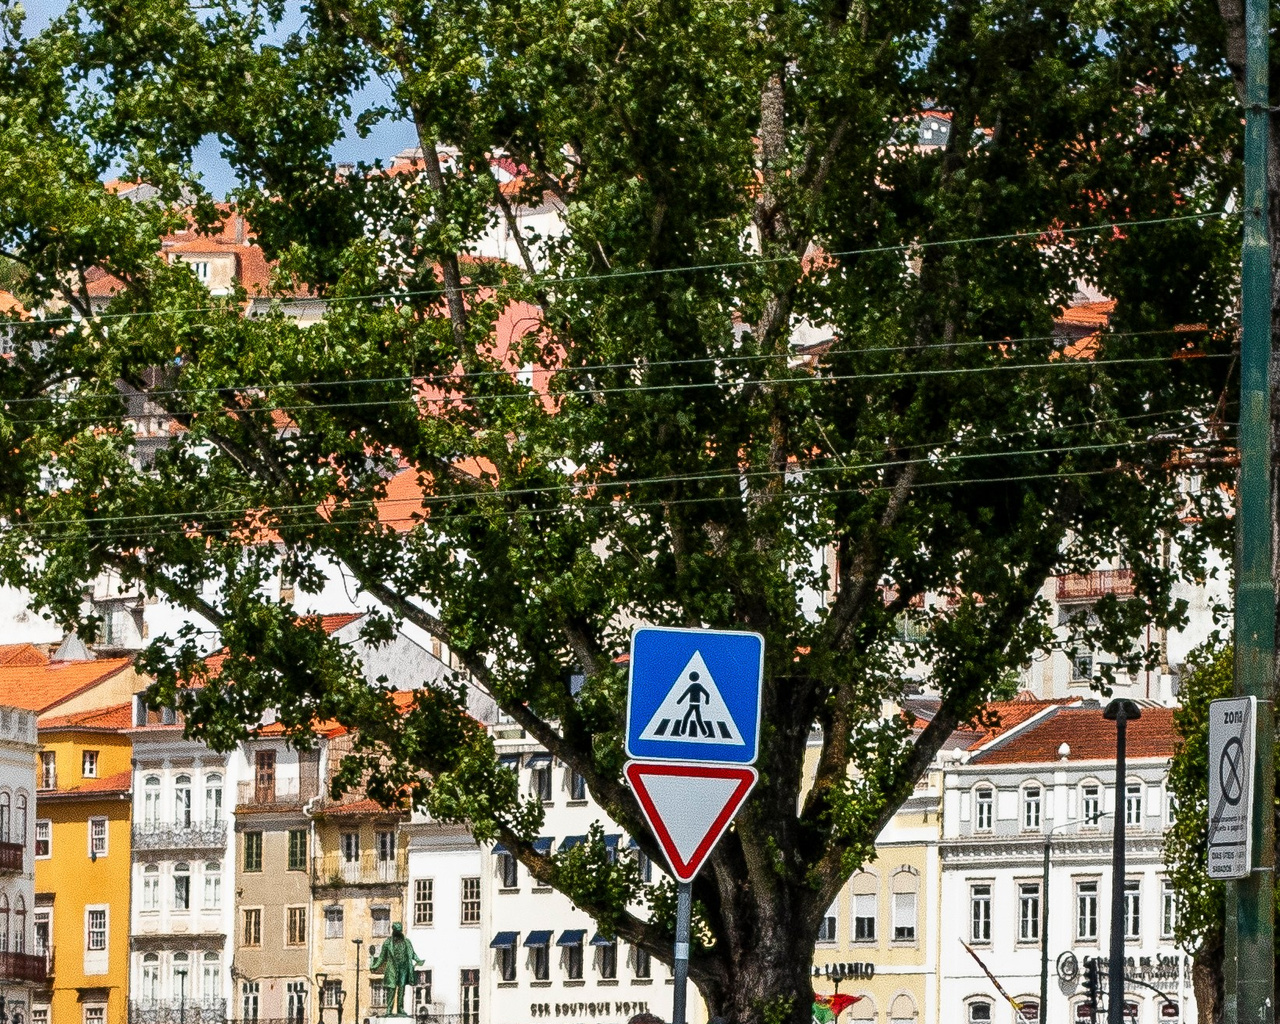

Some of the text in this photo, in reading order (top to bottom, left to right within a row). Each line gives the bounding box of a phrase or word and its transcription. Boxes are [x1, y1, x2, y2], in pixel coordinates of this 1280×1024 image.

[1224, 711, 1242, 724] zona
[555, 1001, 610, 1018] BOUTIQUE
[615, 1001, 650, 1016] HOTEL
